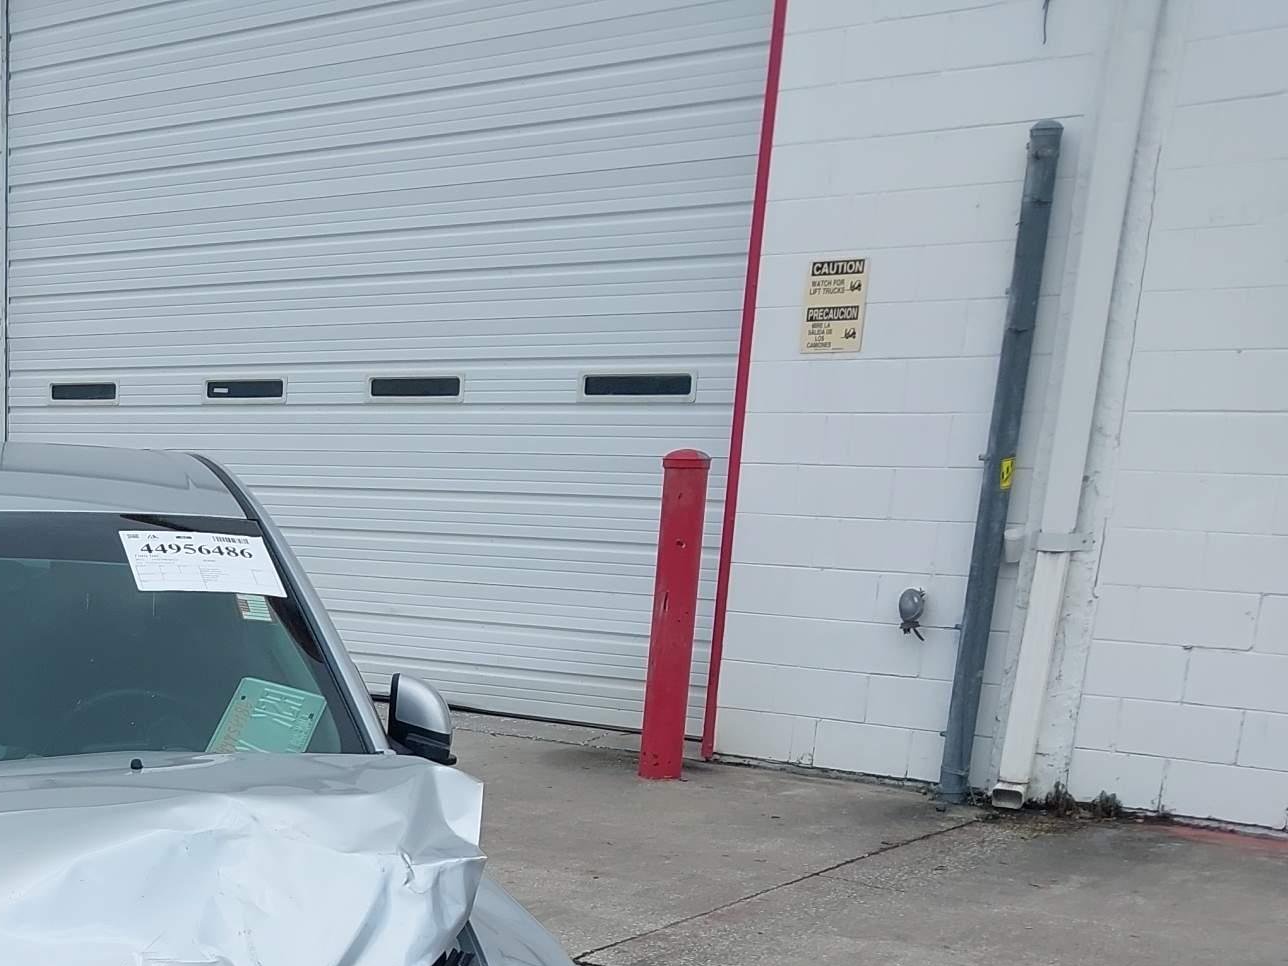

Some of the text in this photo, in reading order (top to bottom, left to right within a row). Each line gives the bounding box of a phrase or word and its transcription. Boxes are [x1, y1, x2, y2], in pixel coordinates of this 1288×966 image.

[813, 260, 864, 275] CAUTION
[811, 278, 845, 287] WATCH FOR
[809, 286, 845, 295] LIFT TRUCKS
[807, 307, 858, 321] PRECAUCION
[140, 542, 253, 560] 44956486
